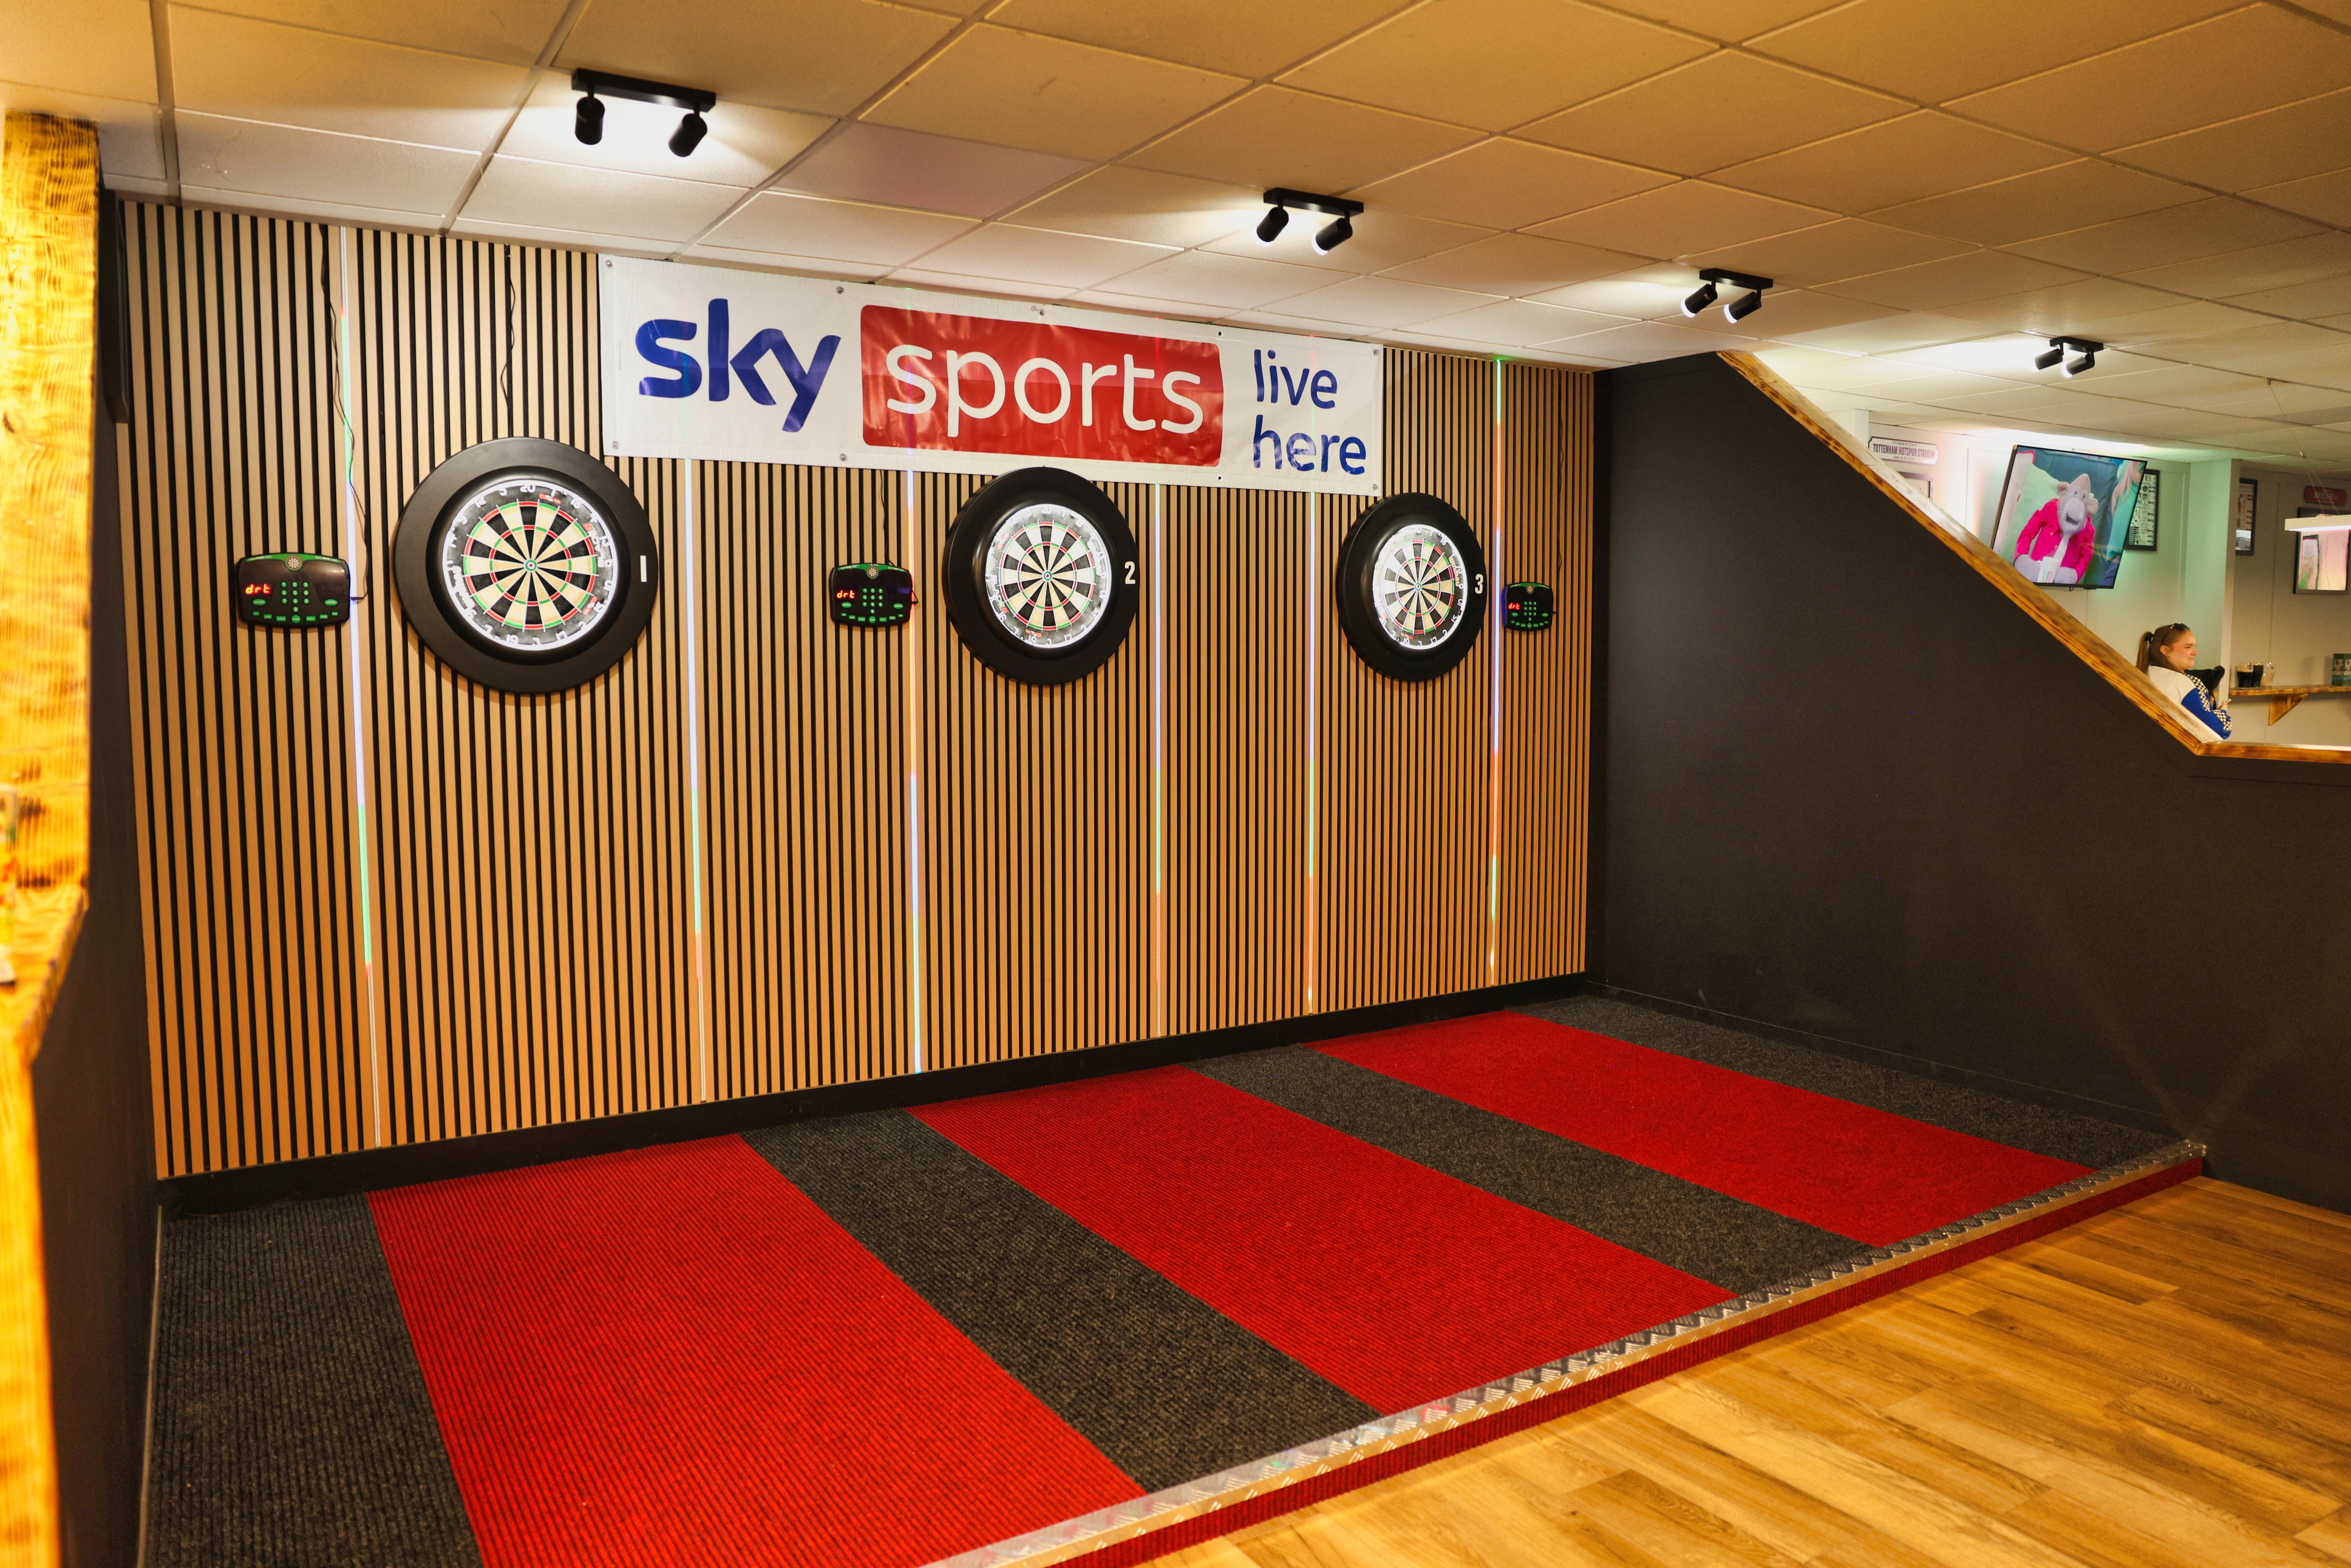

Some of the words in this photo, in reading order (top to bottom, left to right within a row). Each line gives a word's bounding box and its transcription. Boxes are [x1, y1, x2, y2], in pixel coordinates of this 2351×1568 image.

[635, 297, 841, 433] sky
[885, 344, 1203, 438] sports
[1253, 349, 1338, 410] live
[1252, 415, 1367, 476] here
[1873, 443, 1898, 455] TOTTENHAM
[1899, 446, 1917, 456] HOTSPUR
[1917, 449, 1935, 458] STADIUM
[520, 484, 536, 493] 20
[1124, 561, 1136, 585] 2
[245, 583, 271, 595] drt
[837, 589, 855, 599] drt
[1474, 574, 1484, 594] 3
